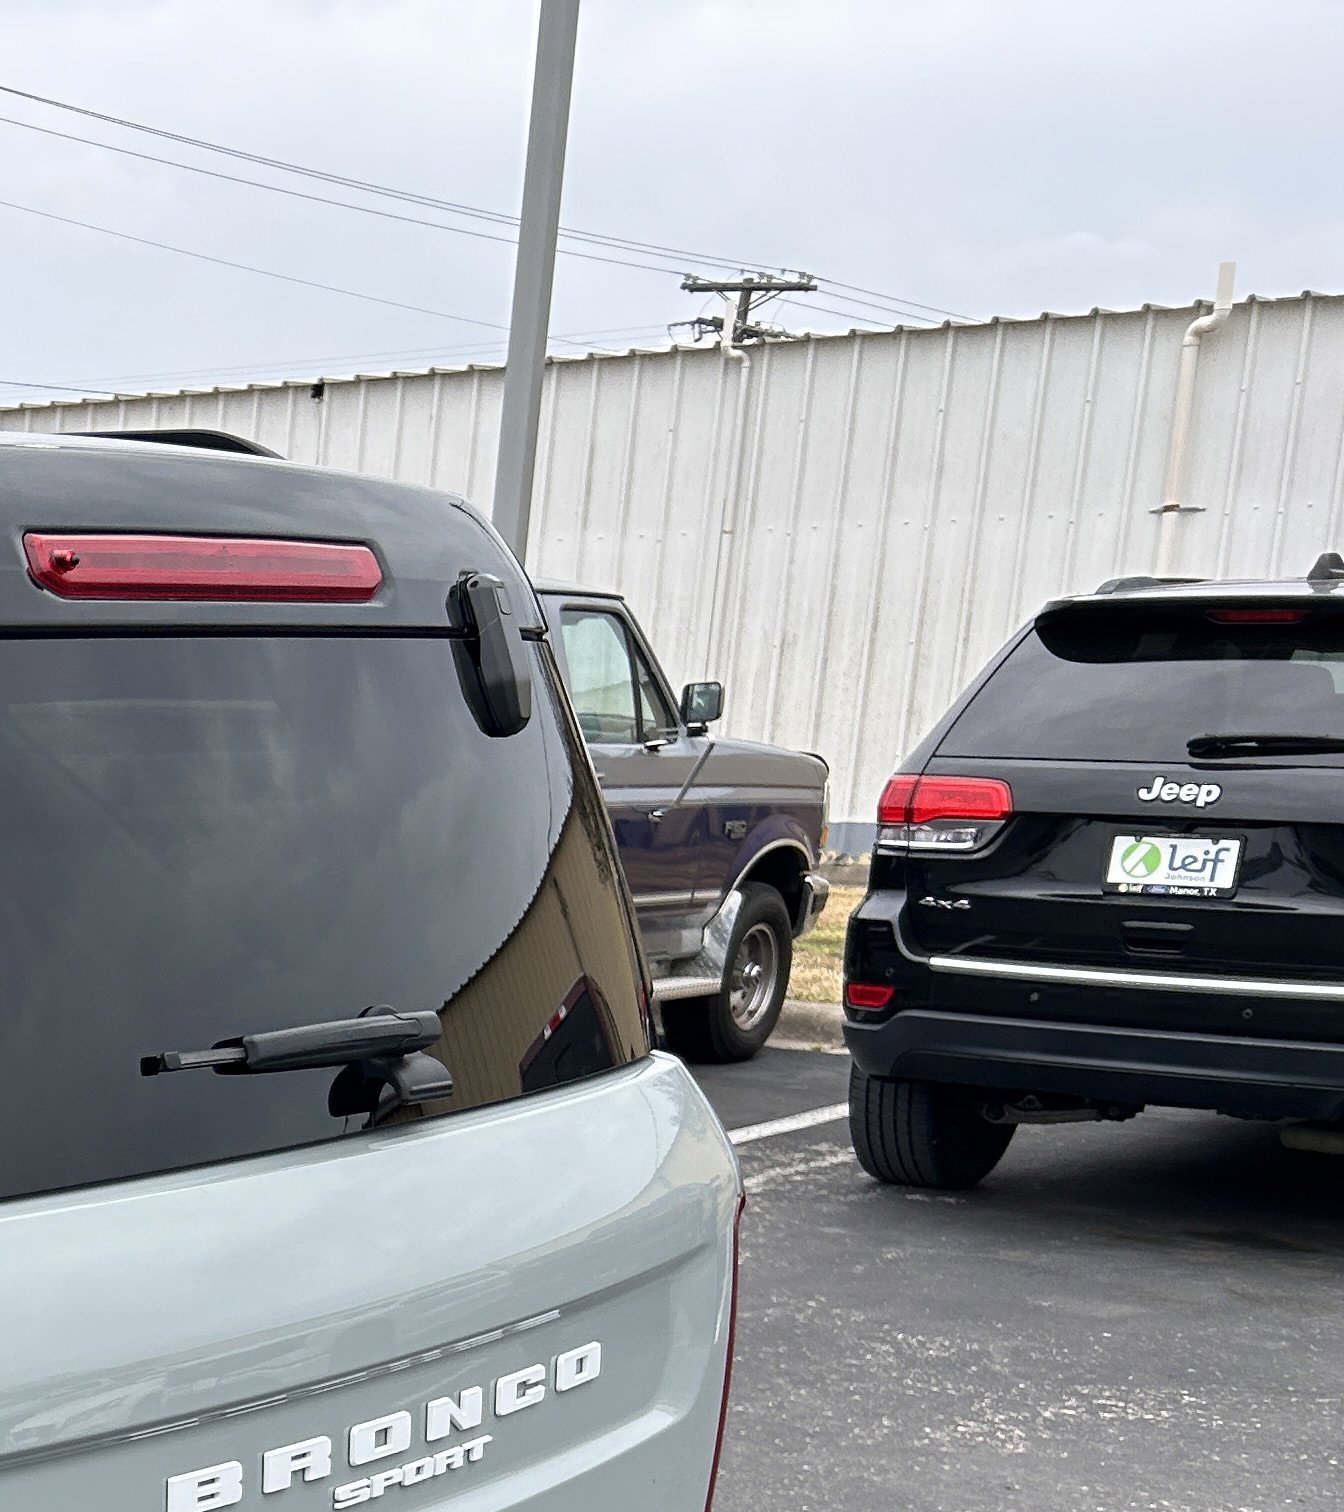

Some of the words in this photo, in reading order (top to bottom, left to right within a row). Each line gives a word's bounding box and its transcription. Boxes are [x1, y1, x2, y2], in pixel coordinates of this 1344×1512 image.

[1138, 776, 1221, 807] Jeep
[1169, 844, 1231, 882] leif
[1203, 888, 1218, 896] TX
[333, 1435, 493, 1510] SPORT
